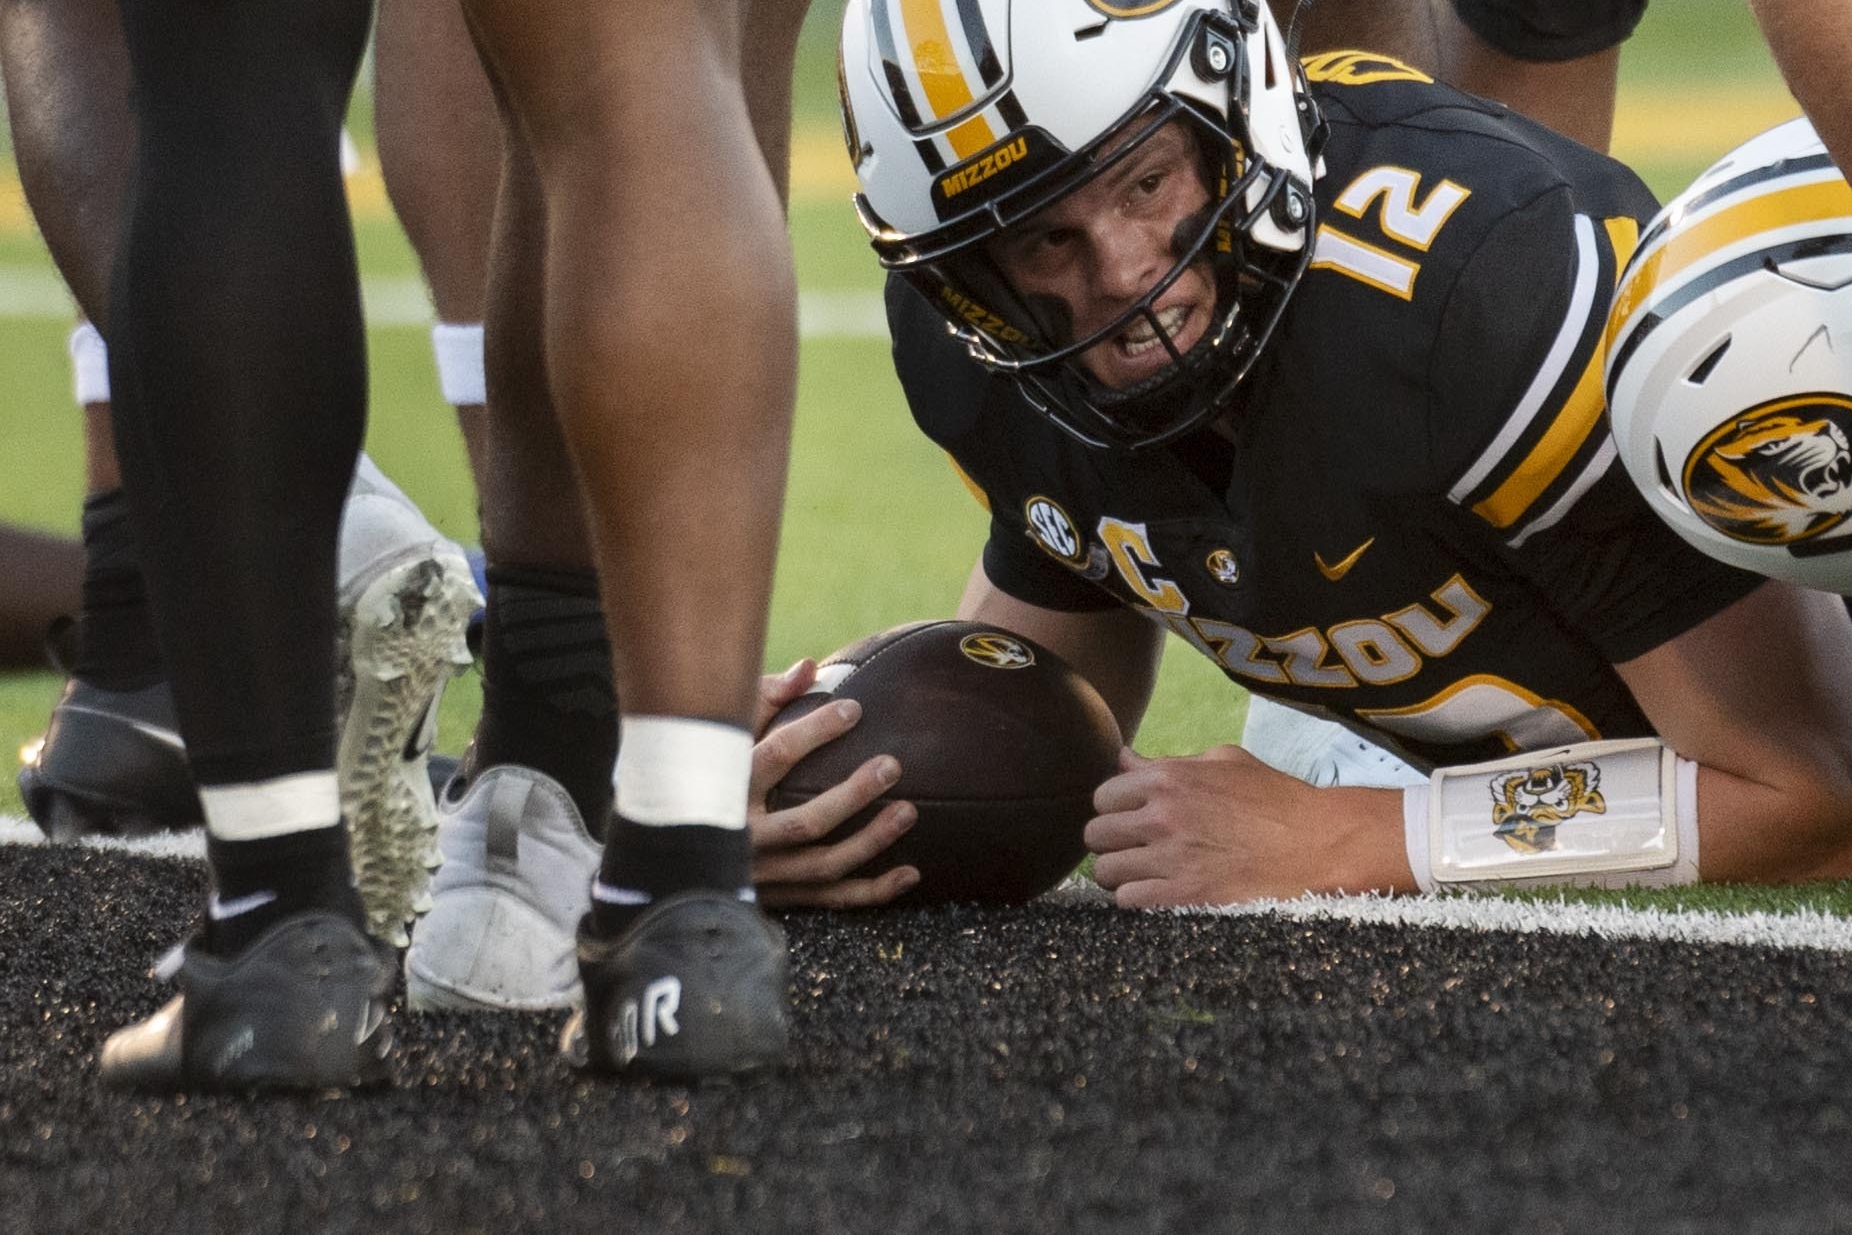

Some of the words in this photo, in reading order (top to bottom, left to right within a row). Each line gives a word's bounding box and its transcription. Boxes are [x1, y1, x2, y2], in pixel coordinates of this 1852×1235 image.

[941, 136, 1028, 198] MIZZOU
[1309, 165, 1472, 302] 12
[1029, 502, 1077, 557] SEC
[1148, 573, 1492, 688] IZZOU
